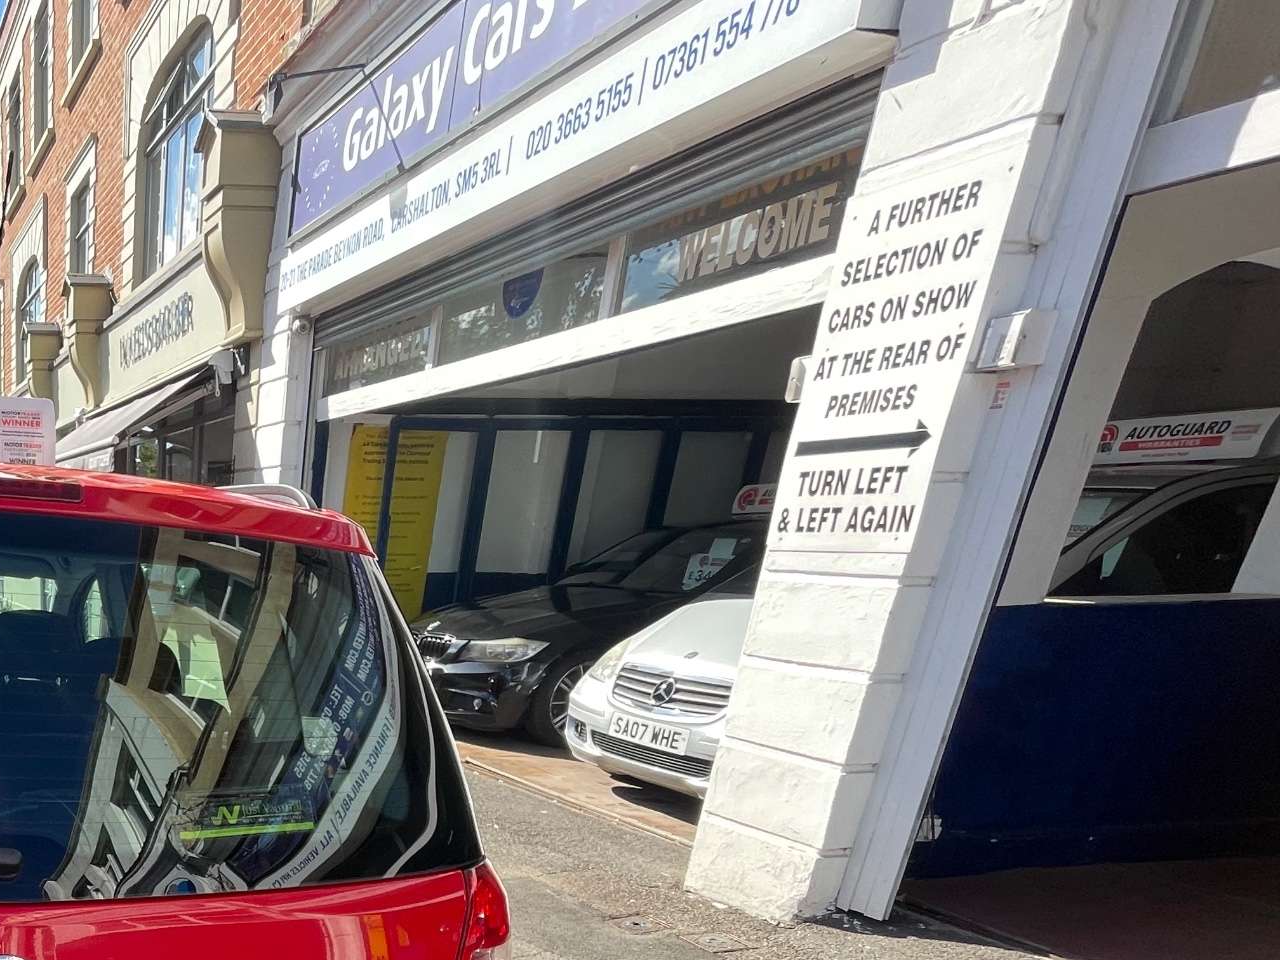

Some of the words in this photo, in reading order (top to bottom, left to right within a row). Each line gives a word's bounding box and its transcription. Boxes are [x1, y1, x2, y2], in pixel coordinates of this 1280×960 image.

[342, 46, 455, 172] Galaxy
[463, 0, 555, 85] Cars
[297, 260, 308, 283] THE
[308, 246, 333, 278] PARADE
[333, 230, 362, 265] BEYNON
[390, 178, 452, 234] CARSHALTON,
[454, 161, 480, 198] SM5
[480, 147, 502, 184] 3RL
[525, 120, 552, 160] 020
[554, 97, 593, 143] 3663
[594, 72, 634, 122] 5155
[652, 26, 711, 90] 07361
[713, 0, 756, 57] 554
[678, 182, 839, 282] WELCOME
[867, 210, 881, 237] A
[885, 180, 983, 232] FURTHER
[841, 237, 948, 287] SELECTION
[952, 228, 984, 261] OF
[828, 300, 876, 334] CARS
[880, 294, 910, 324] ON
[912, 280, 978, 318] SHOW
[813, 355, 839, 381] AT
[841, 348, 877, 377] THE
[878, 340, 931, 372] REAR
[935, 332, 967, 362] OF
[1, 419, 41, 428] WINNER
[824, 383, 918, 418] PREMISES
[1125, 420, 1232, 441] AUTOGUARD
[798, 469, 851, 497] TURN
[854, 465, 909, 495] LEFT
[777, 507, 791, 533] &
[795, 506, 843, 533] LEFT
[844, 505, 917, 533] AGAIN
[614, 717, 649, 740] SA07
[650, 726, 682, 750] WHE
